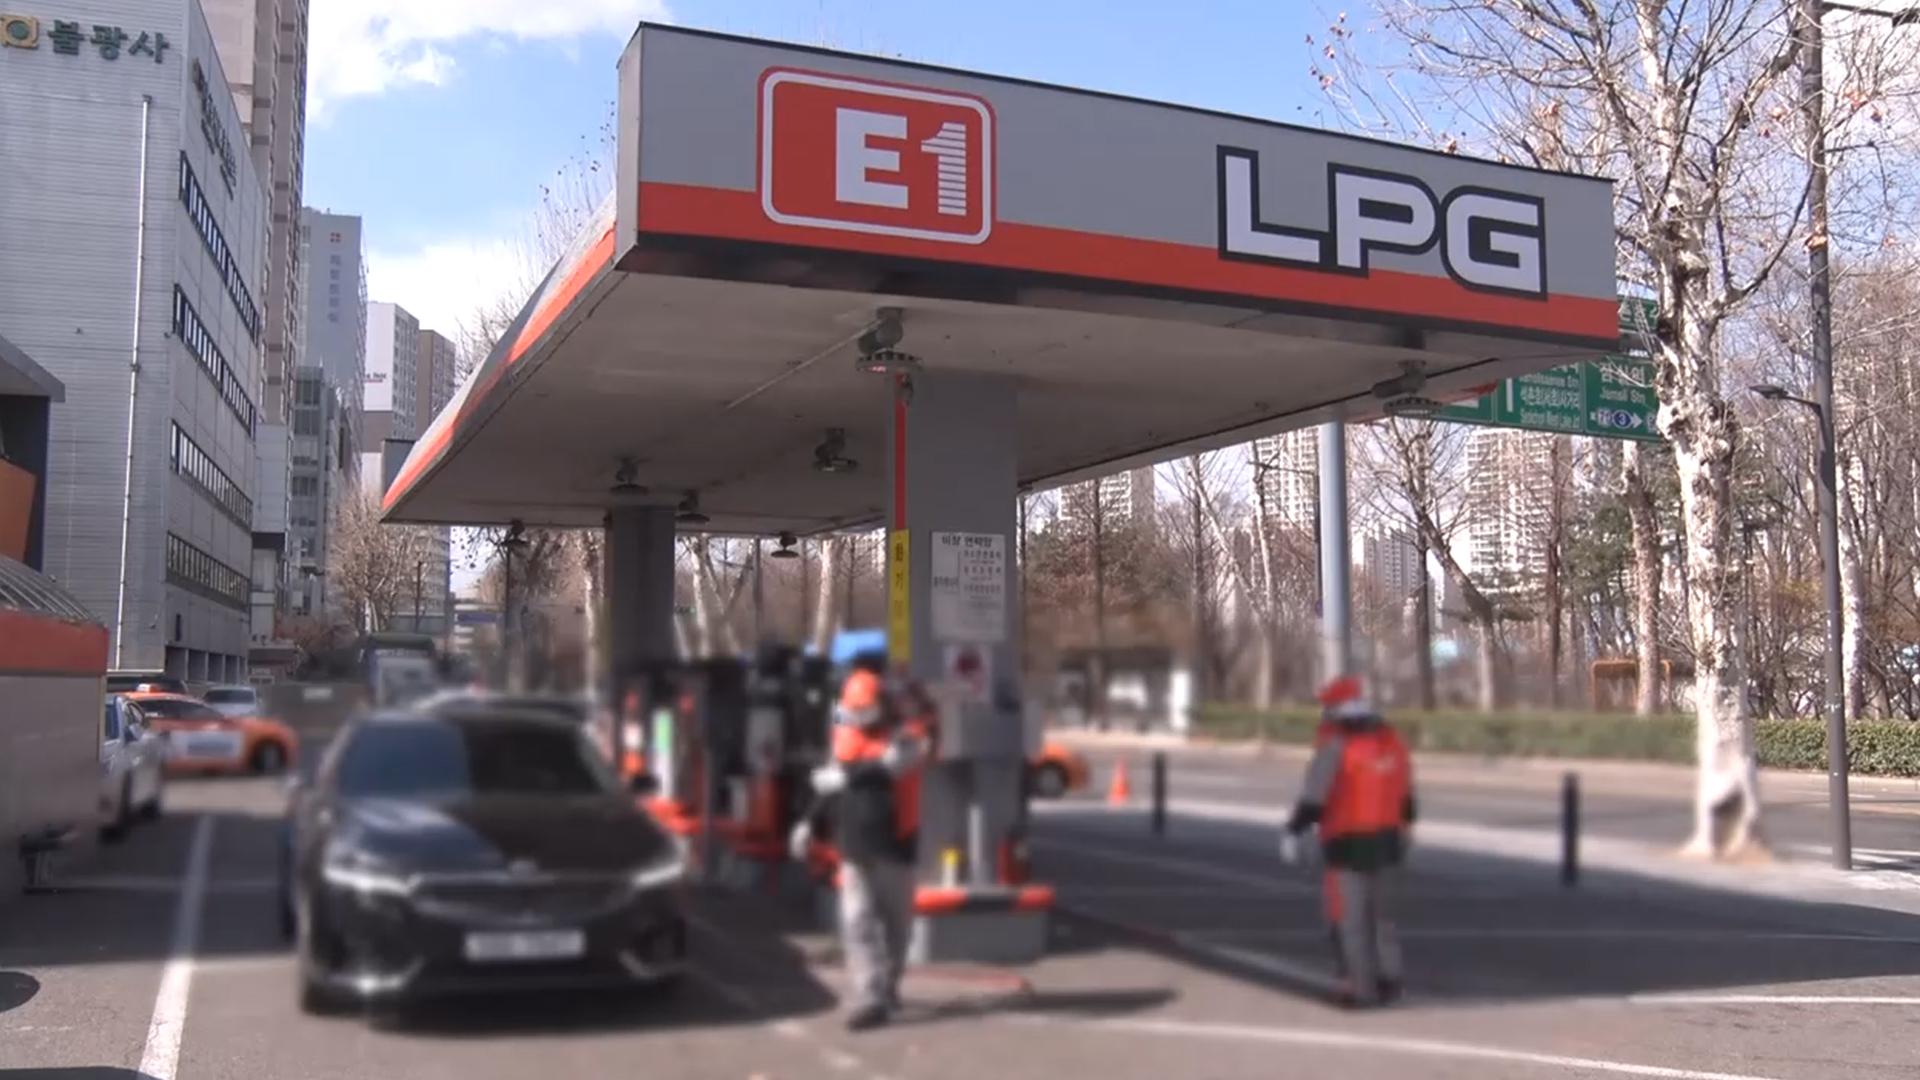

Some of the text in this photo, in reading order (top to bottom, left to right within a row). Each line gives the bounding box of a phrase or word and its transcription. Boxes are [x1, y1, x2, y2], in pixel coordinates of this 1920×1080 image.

[48, 20, 170, 63] 불광사
[836, 107, 967, 217] E1
[1218, 146, 1546, 299] LPG
